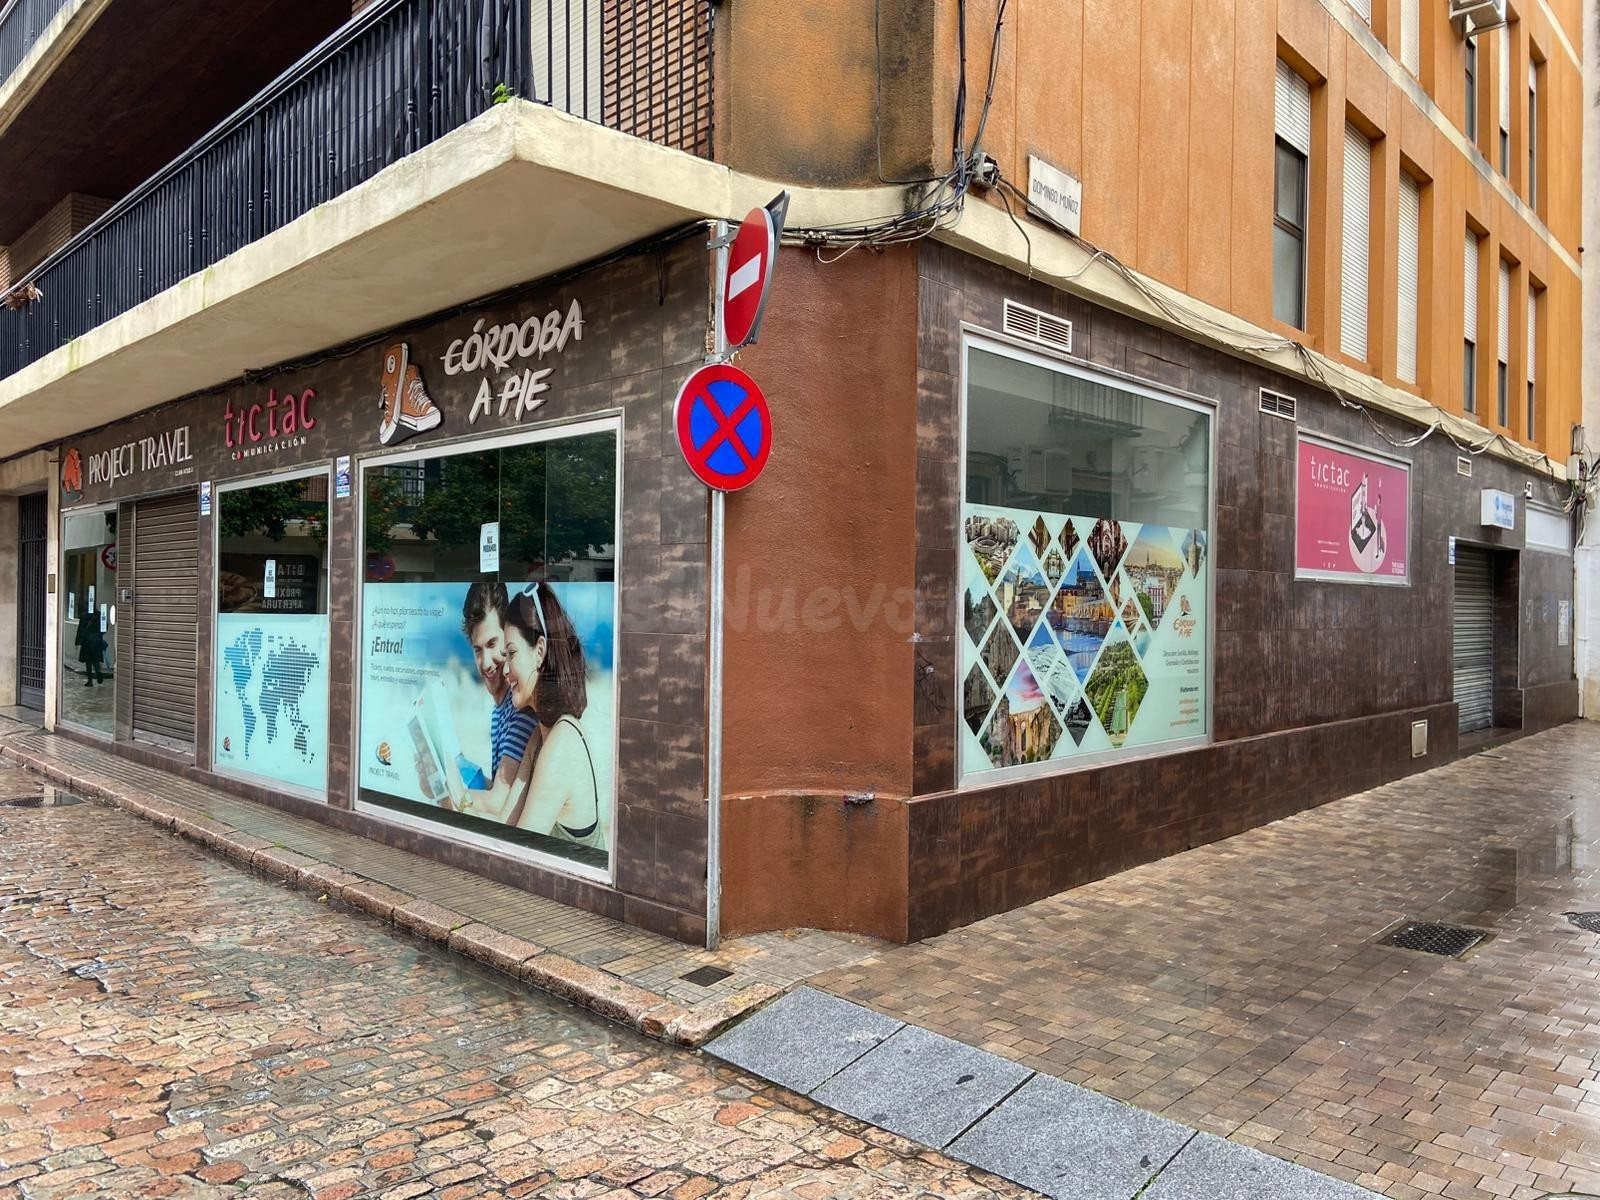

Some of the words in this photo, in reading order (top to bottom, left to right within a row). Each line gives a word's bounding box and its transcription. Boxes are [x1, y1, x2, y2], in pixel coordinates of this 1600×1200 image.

[1032, 179, 1058, 204] DOMINGO
[1060, 194, 1079, 215] MUÑOZ
[440, 298, 586, 376] CÓRDOBA
[224, 388, 317, 449] tictac
[468, 376, 494, 425] A
[497, 367, 554, 422] PIE
[89, 442, 136, 489] PROJECT
[138, 425, 193, 472] TRAVEL
[231, 436, 308, 461] COMUNICACIÓN
[1310, 455, 1350, 488] tictac
[371, 636, 404, 656] ¡Entra!
